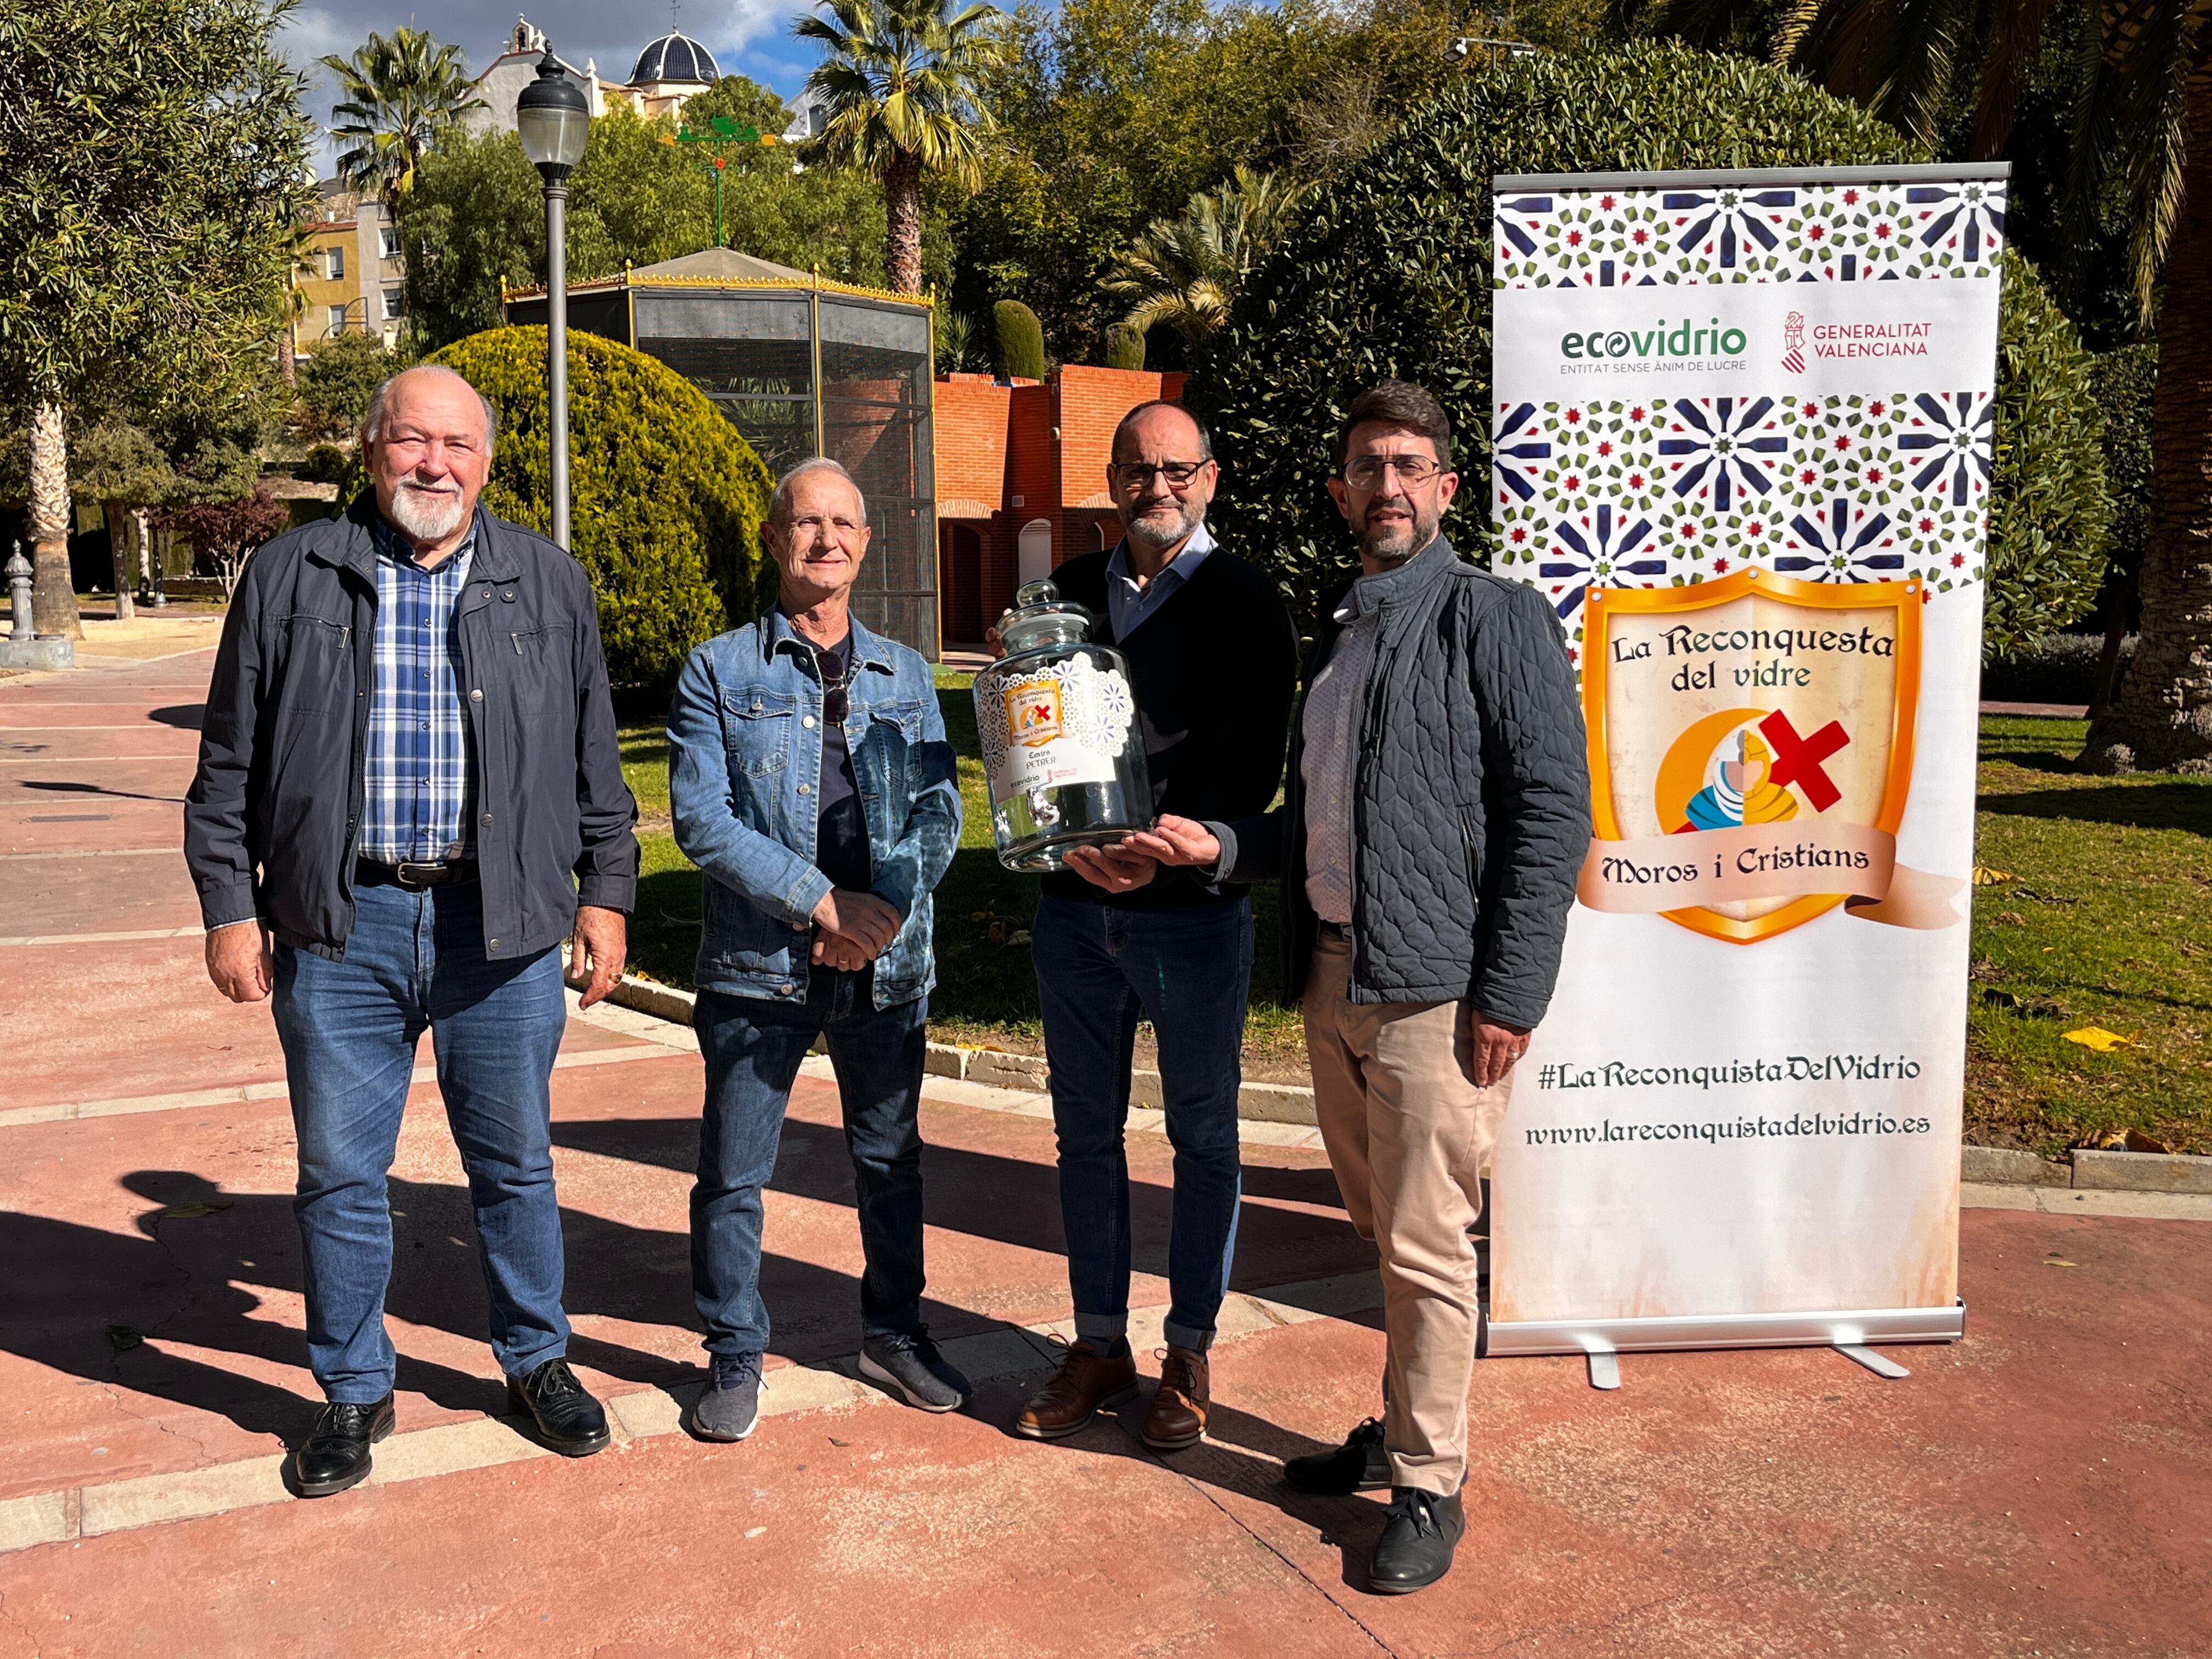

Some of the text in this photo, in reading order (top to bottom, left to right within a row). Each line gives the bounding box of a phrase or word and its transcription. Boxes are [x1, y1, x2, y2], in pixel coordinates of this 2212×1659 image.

[1561, 317, 1747, 359] ecovidrio
[1813, 323, 1932, 340] GENERALITAT
[1814, 341, 1928, 358] VALENCIANA
[1560, 360, 1747, 375] ENTITAT SENSE ÀNIM DE LUCRE
[1611, 624, 1895, 663] La Reconquesta
[1671, 658, 1812, 692] del vidre
[1011, 775, 1040, 788] ecovidrio
[1601, 843, 1870, 884] Moros i Cristians
[1524, 1111, 1931, 1144] www.lareconquistadelvidrio.es
